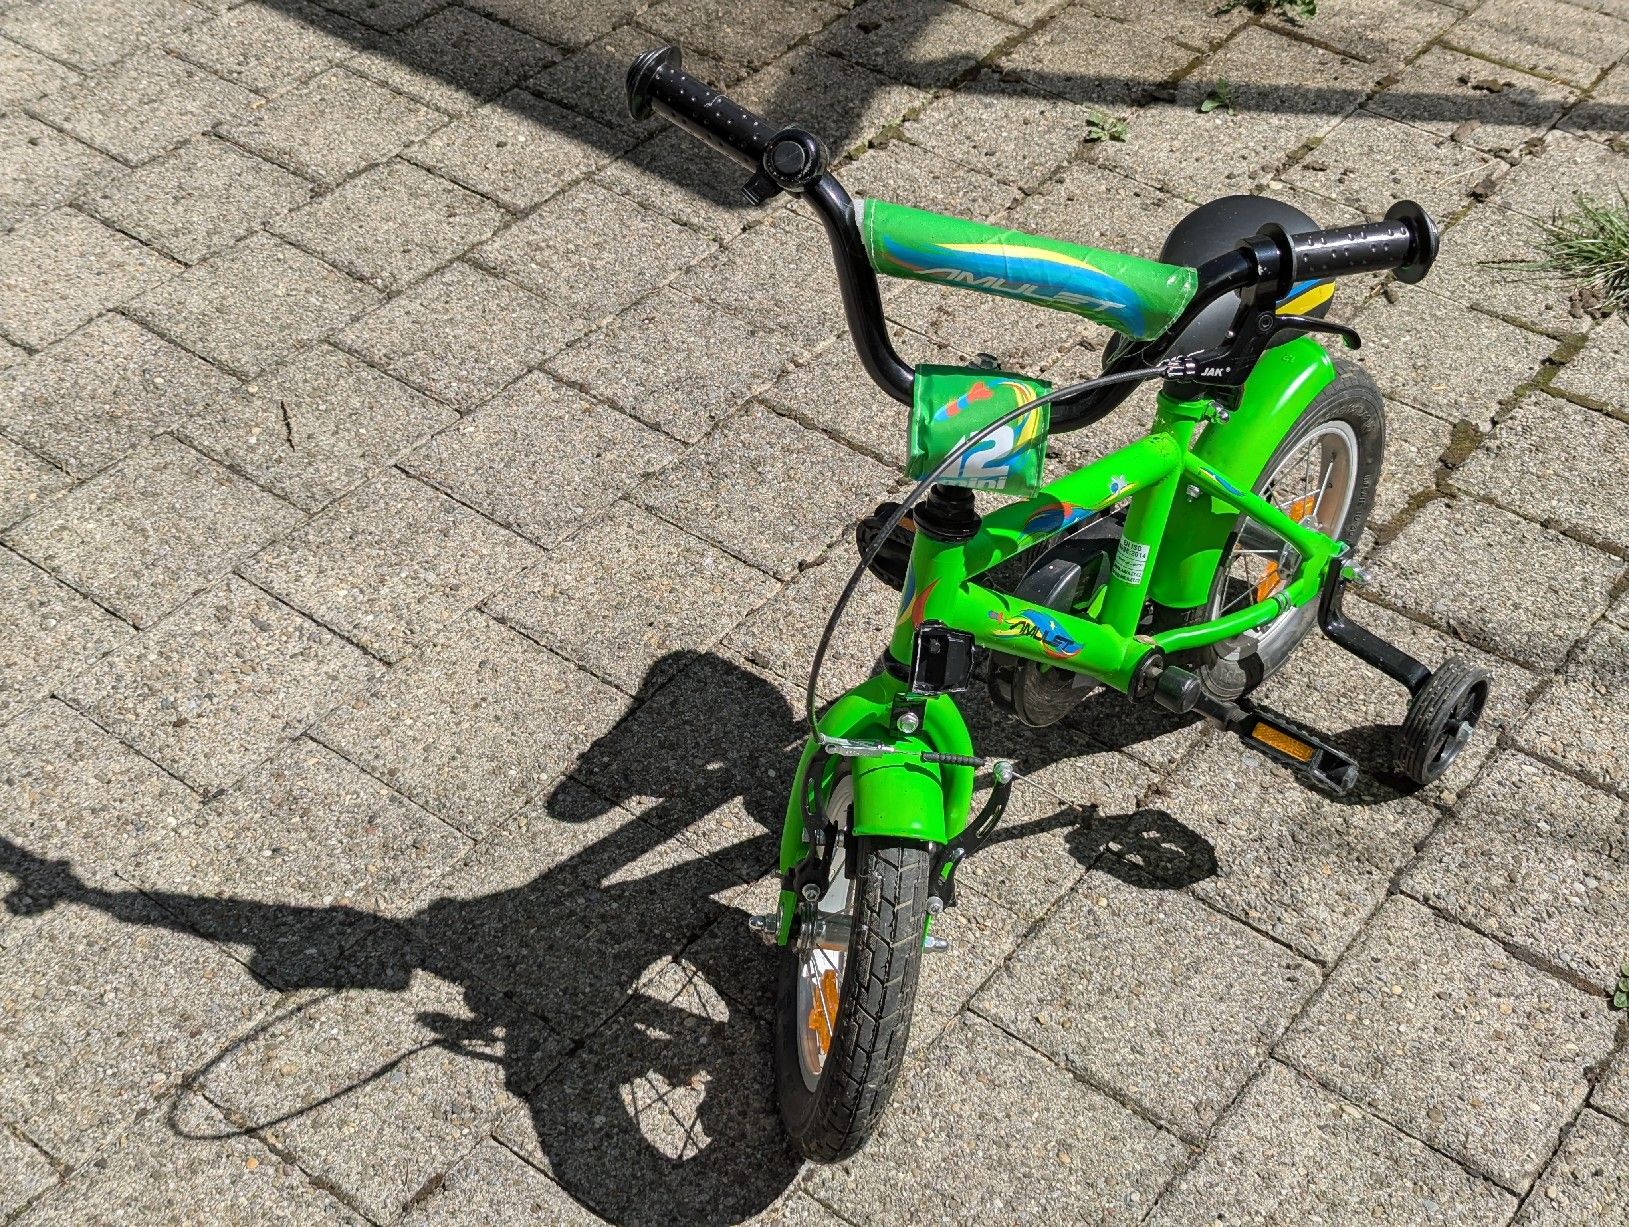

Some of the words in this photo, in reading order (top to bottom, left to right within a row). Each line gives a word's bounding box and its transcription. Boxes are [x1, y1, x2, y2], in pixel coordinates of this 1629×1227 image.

[914, 268, 1127, 311] AMULET
[1201, 367, 1224, 376] JAK
[1130, 543, 1142, 552] ISO
[1009, 620, 1075, 650] AMULET
